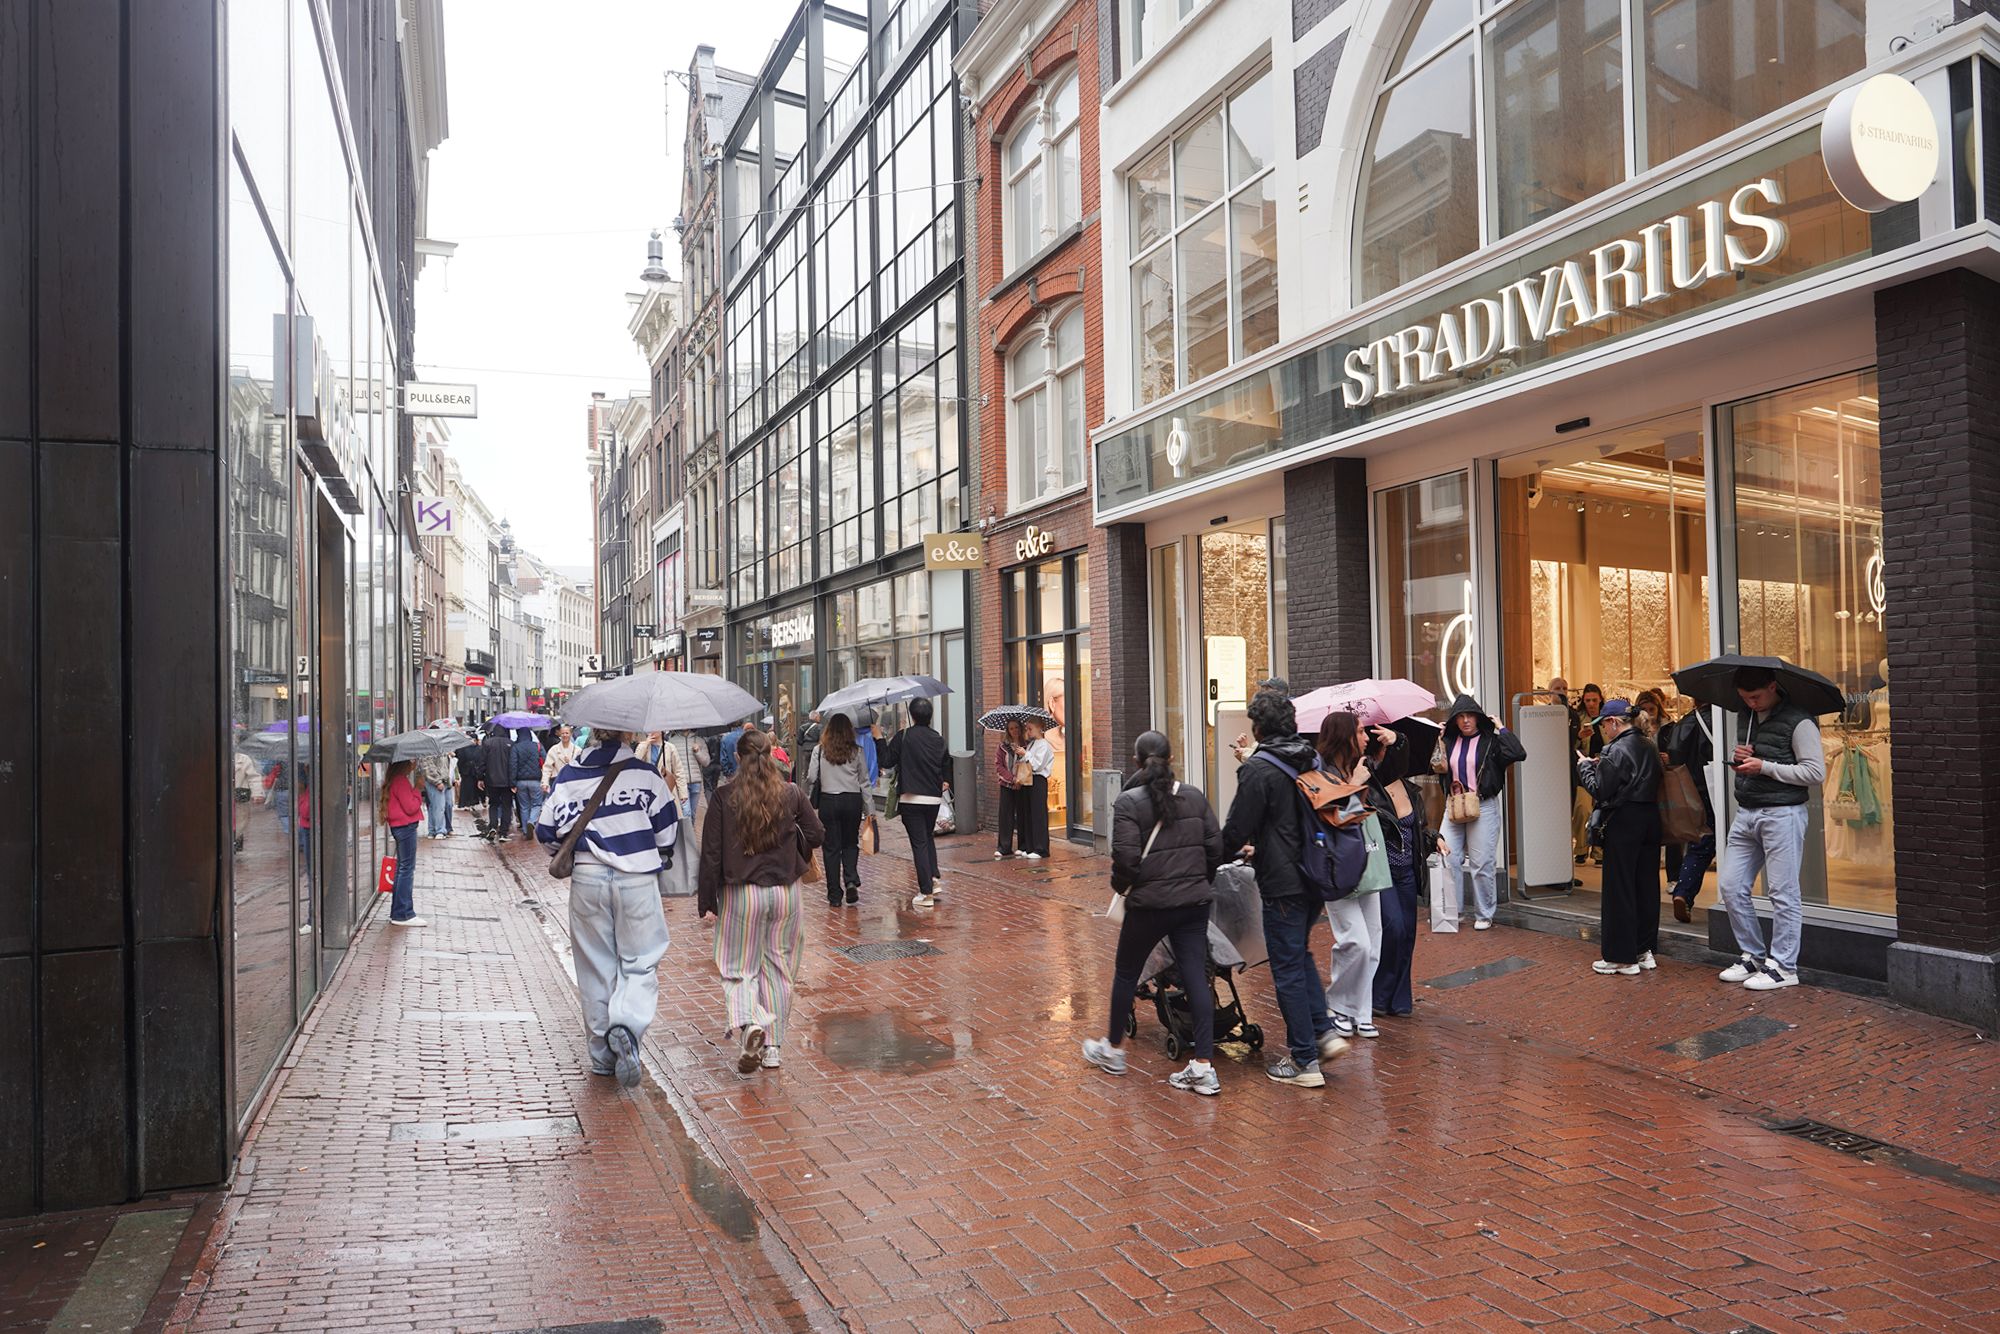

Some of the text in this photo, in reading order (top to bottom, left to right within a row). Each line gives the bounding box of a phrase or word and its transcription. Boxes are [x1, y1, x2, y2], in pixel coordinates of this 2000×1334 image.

[1867, 126, 1933, 151] STRADIVARIUS
[1341, 178, 1788, 409] STRADIVARIUS
[410, 393, 471, 405] PULL&BEAR
[931, 540, 980, 562] e&e
[1016, 525, 1051, 560] e&e
[772, 614, 815, 648] BERSHKA
